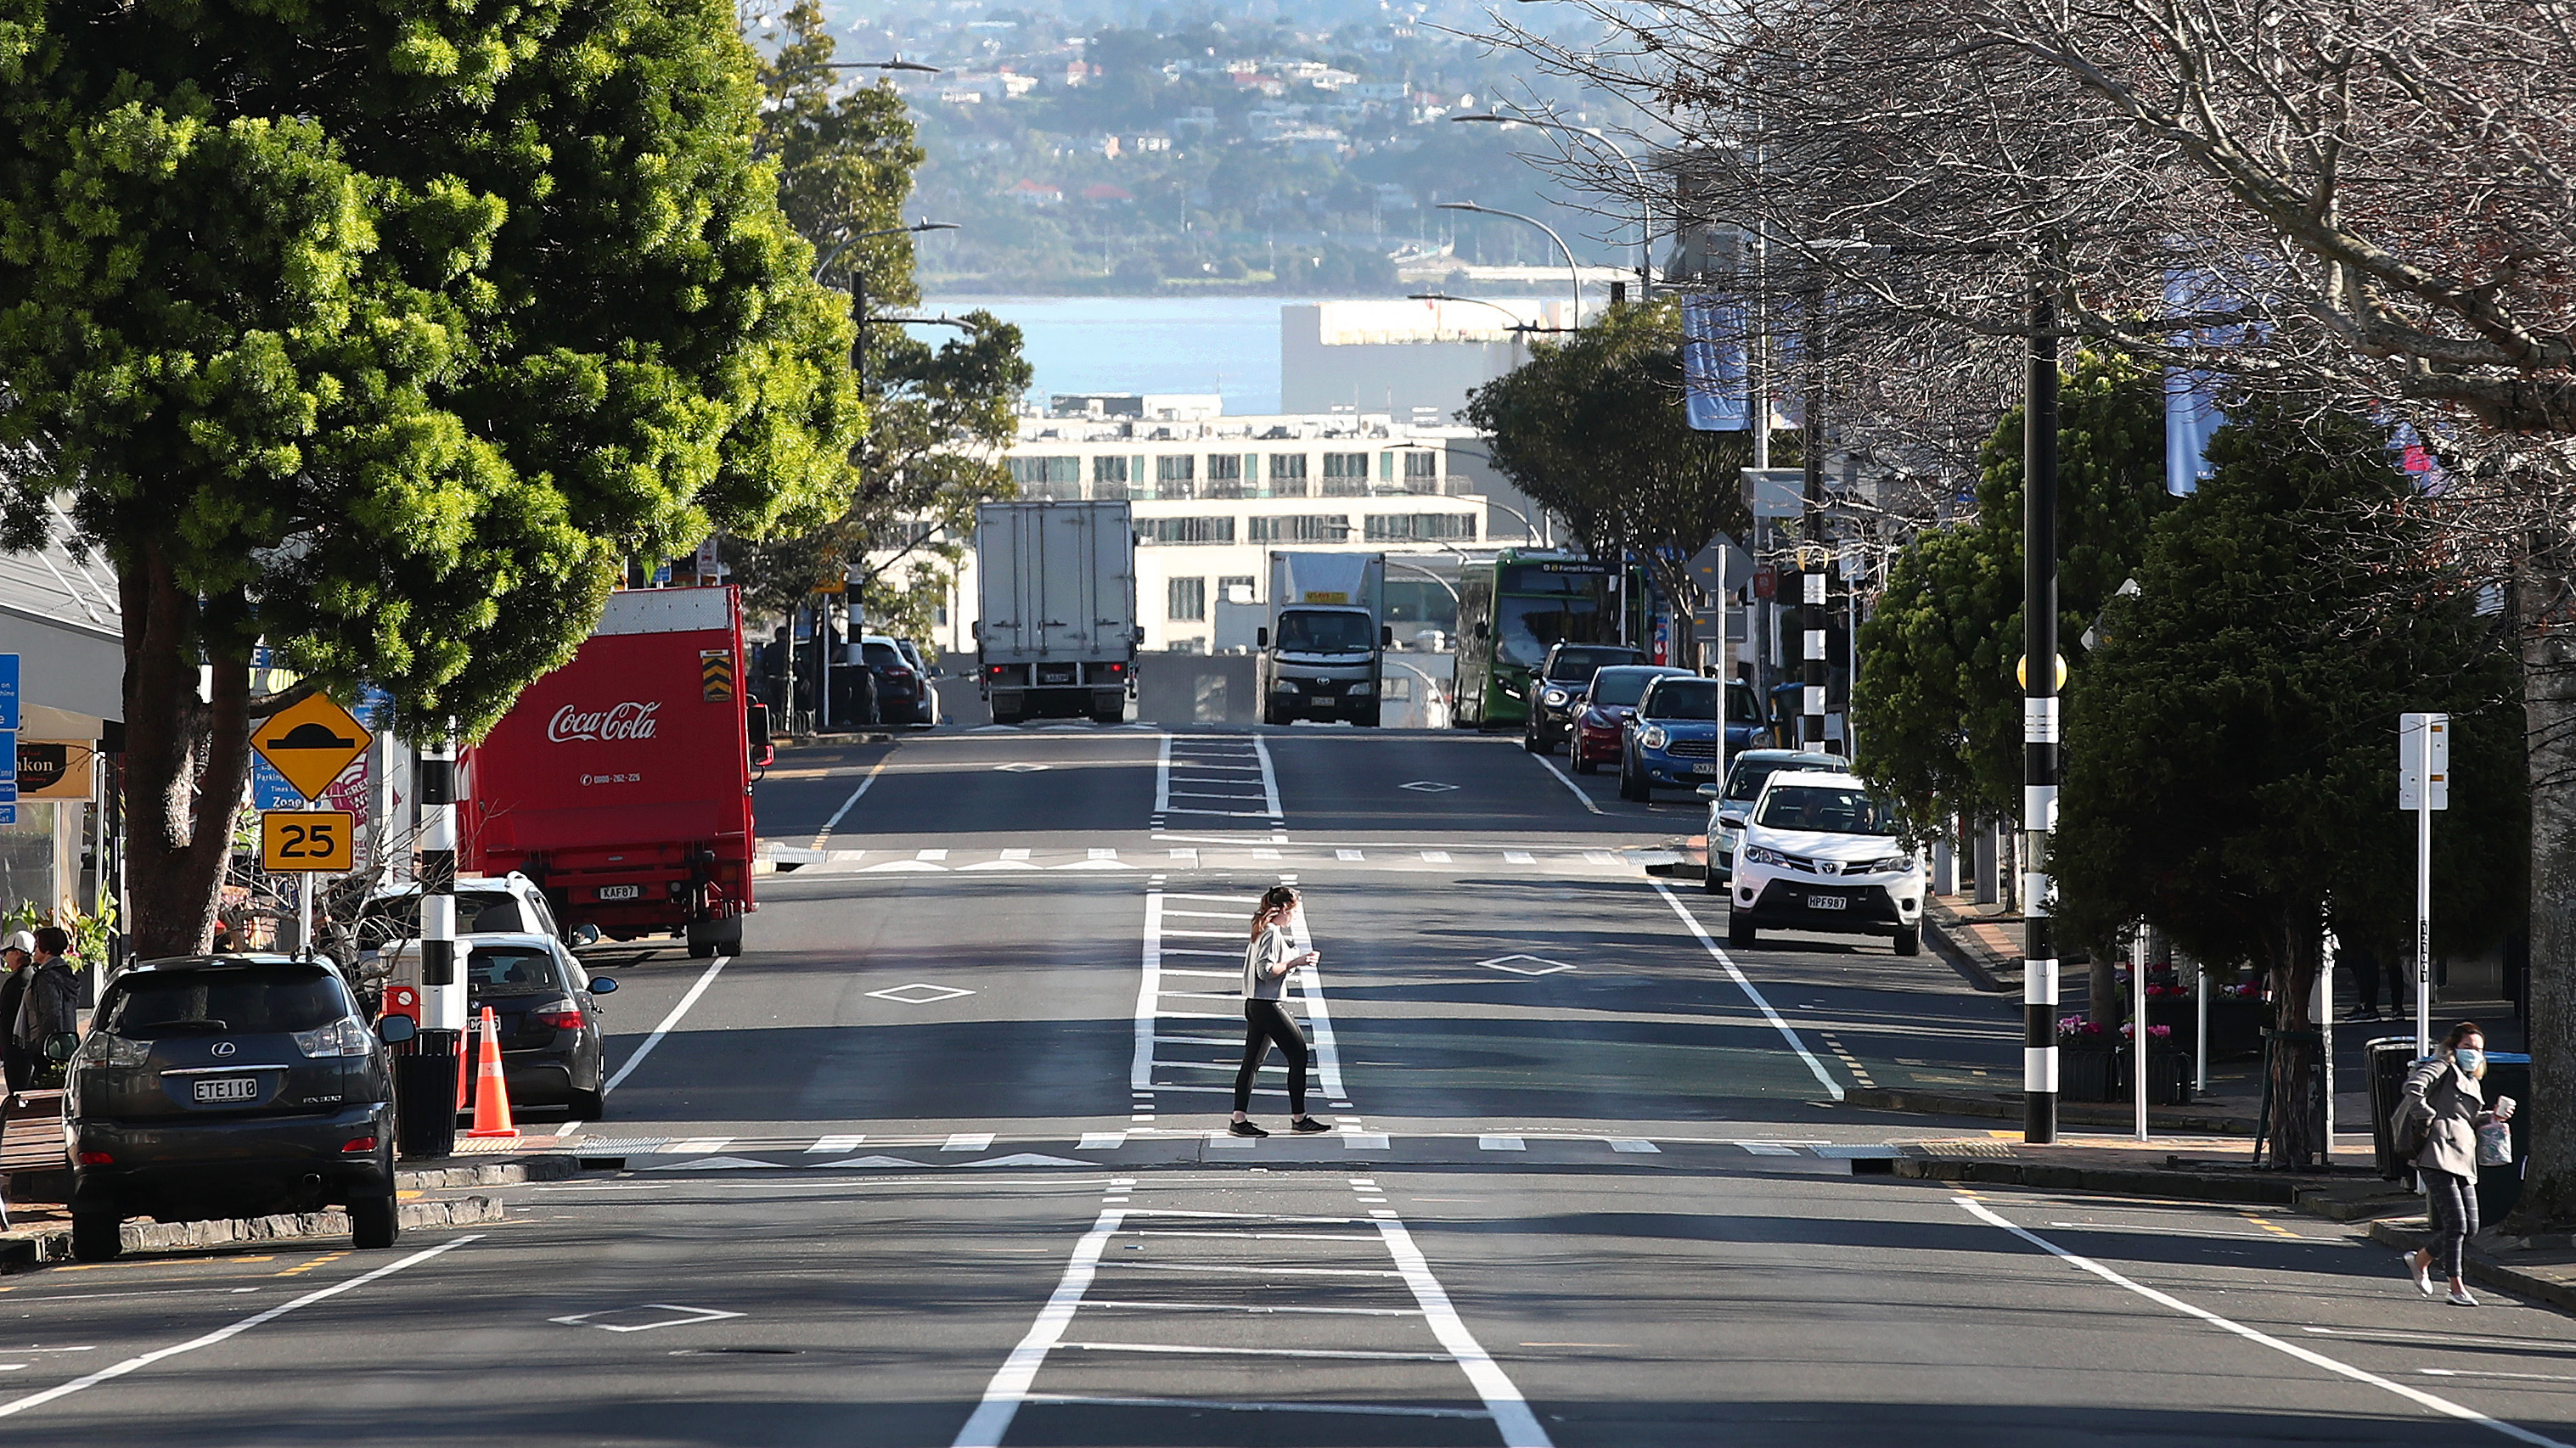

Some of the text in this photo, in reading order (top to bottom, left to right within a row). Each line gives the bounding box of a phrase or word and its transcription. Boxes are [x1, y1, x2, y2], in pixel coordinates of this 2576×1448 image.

[548, 701, 662, 743] Coca-Cola
[272, 796, 302, 808] Zone
[279, 824, 335, 857] 25
[604, 887, 634, 898] KAF87
[1809, 896, 1845, 909] HPF987
[196, 1080, 256, 1098] ETE110
